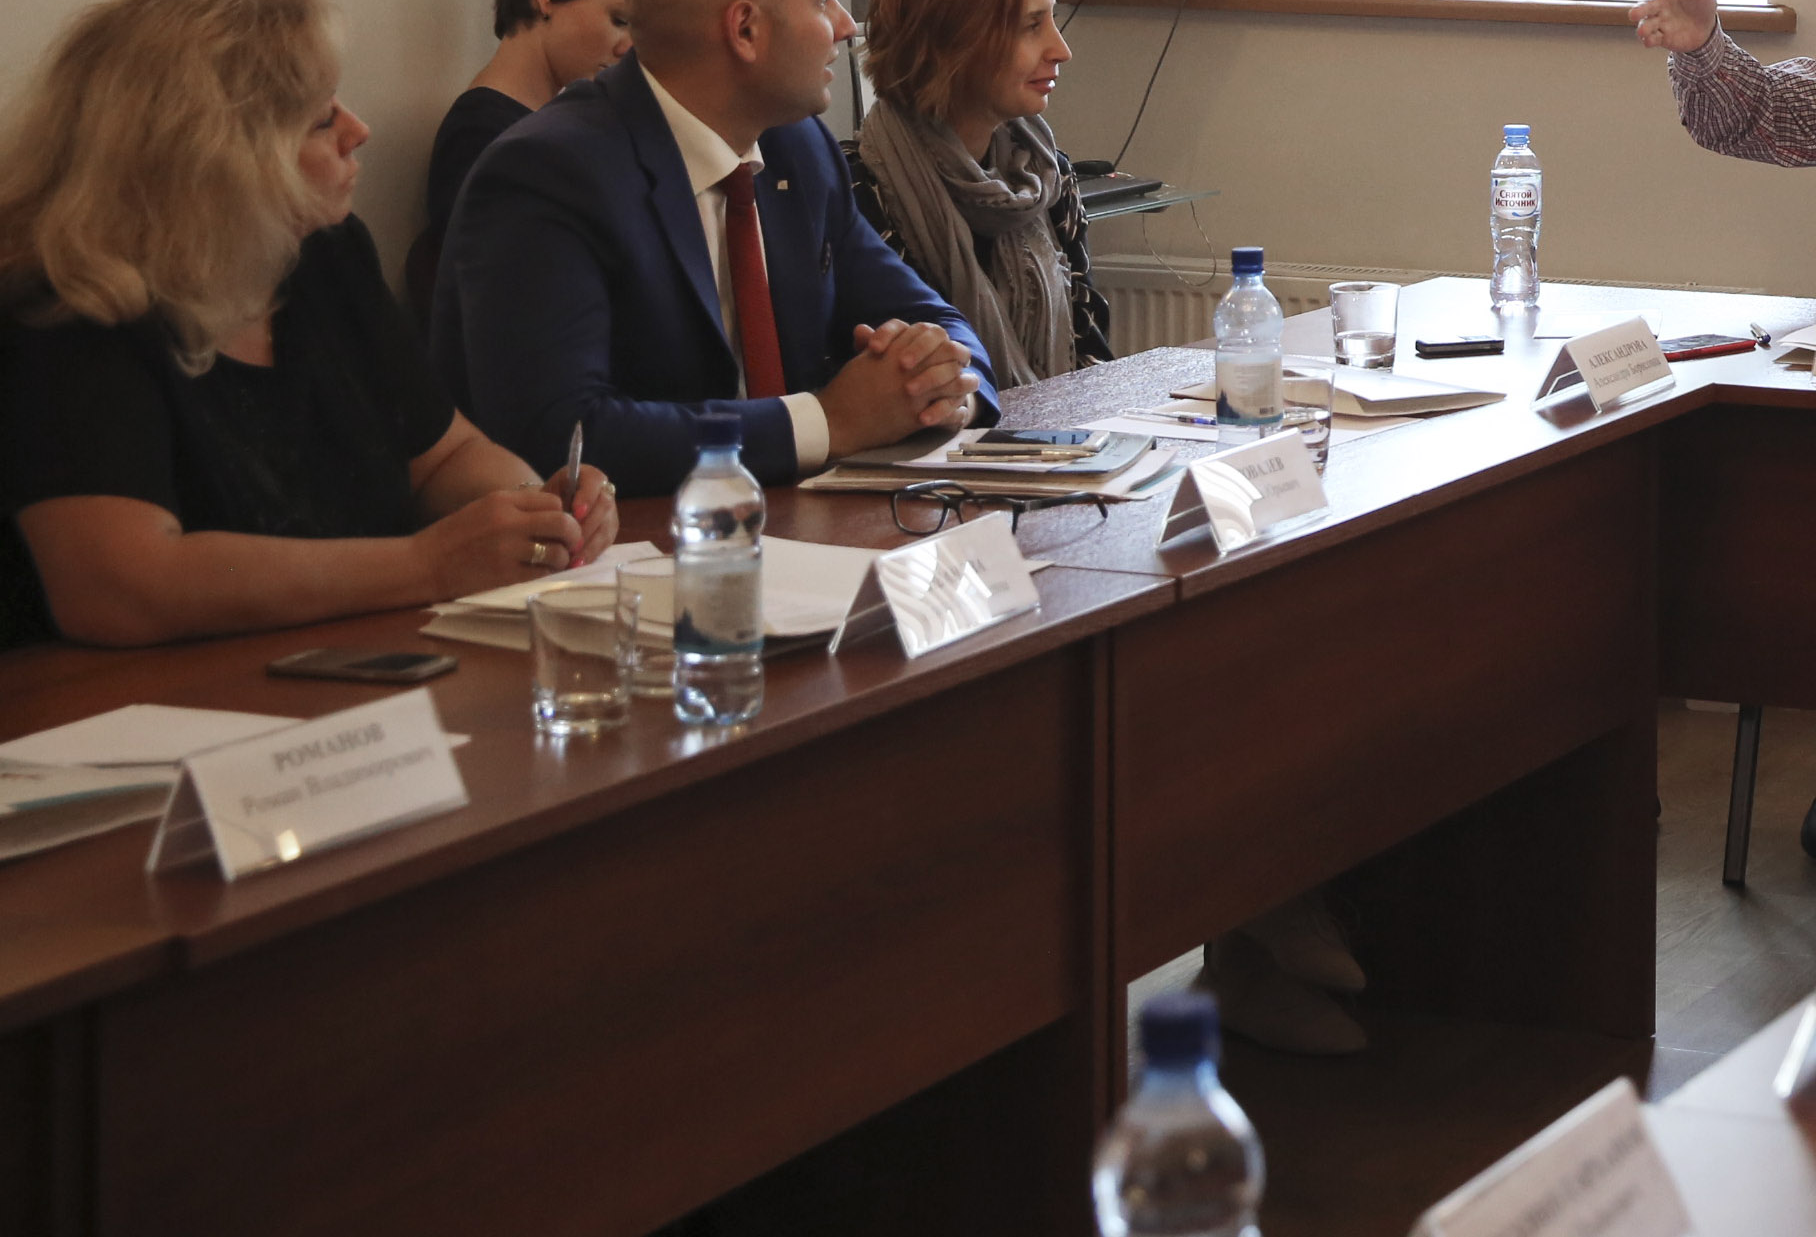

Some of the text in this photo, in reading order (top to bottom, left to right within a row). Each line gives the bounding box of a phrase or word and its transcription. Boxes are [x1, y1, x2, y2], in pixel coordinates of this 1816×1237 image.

[1588, 339, 1649, 370] АЛЕКСАНДРОВА
[1240, 456, 1285, 481] ОВАЛЕВ
[272, 721, 387, 774] РОМАНОВ
